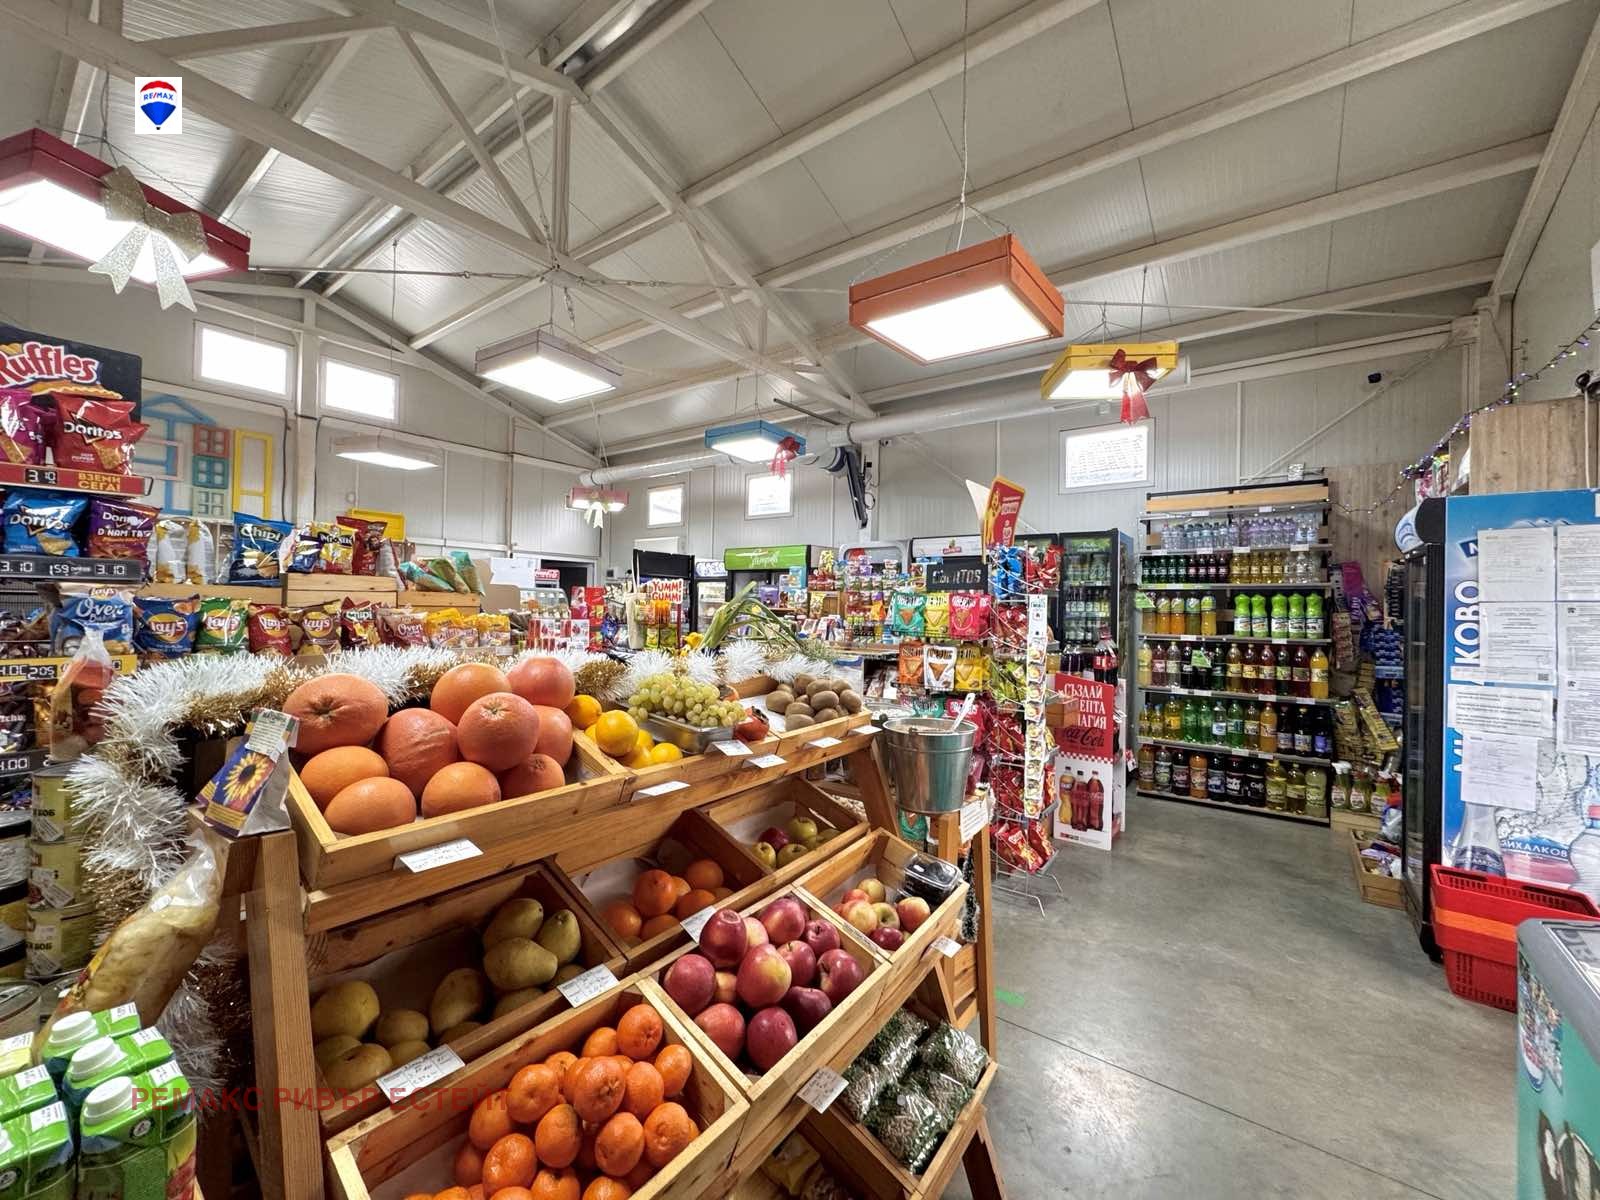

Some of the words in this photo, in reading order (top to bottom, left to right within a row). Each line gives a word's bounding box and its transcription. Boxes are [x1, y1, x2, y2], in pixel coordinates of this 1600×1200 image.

[63, 421, 122, 439] Doritos
[79, 472, 120, 483] ВЗЕМИ
[103, 511, 148, 527] Dori
[1063, 683, 1104, 699] СЪЗДАЙ
[1079, 699, 1106, 715] ЕПТА
[1077, 713, 1107, 730] АГИЯ
